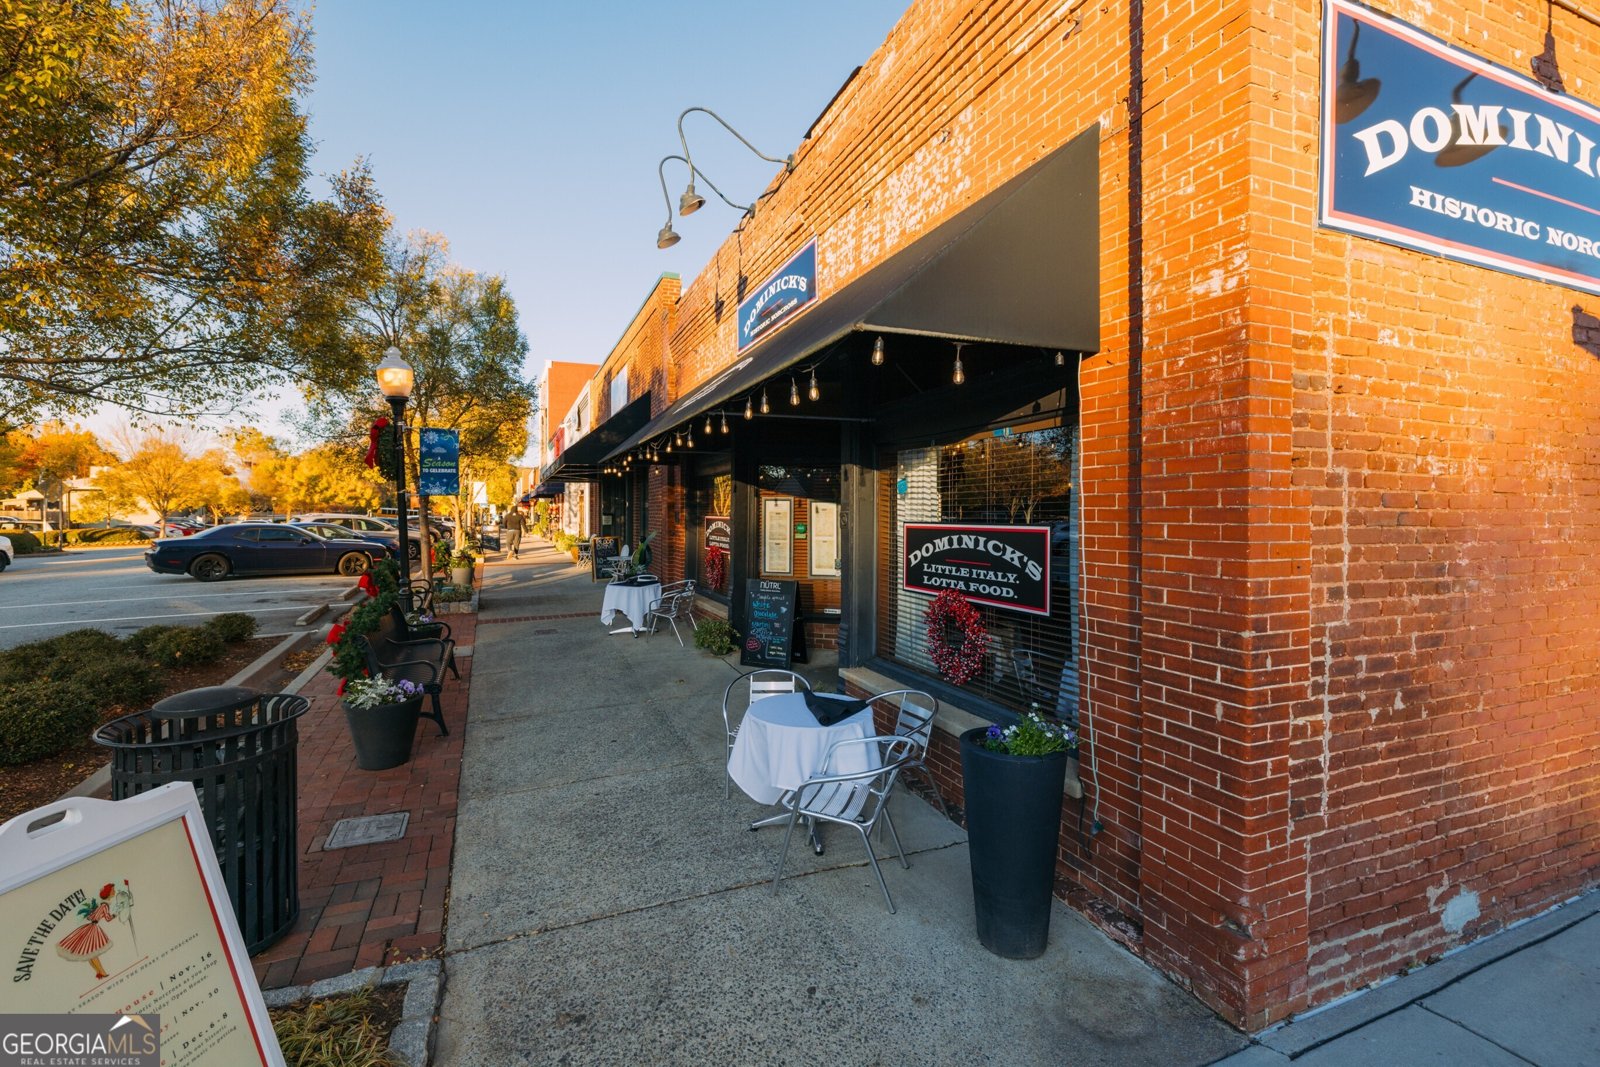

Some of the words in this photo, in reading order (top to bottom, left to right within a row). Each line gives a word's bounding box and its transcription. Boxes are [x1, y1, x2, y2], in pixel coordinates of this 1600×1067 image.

[1352, 104, 1600, 178] DOMINI
[1410, 186, 1540, 240] HISTORIC
[744, 275, 807, 337] DOMINICK'S
[422, 458, 456, 467] Season
[908, 534, 1043, 581] DOMINICK'S
[923, 563, 969, 577] LITTLE
[970, 569, 1020, 584] ITALY.
[923, 576, 967, 591] LOTTA
[969, 583, 1018, 598] FOOD.
[13, 948, 40, 982] SAVE
[27, 919, 56, 946] THE
[49, 888, 87, 922] DATE!
[170, 965, 196, 982] Nov.
[201, 952, 212, 962] 16
[208, 988, 219, 998] 30
